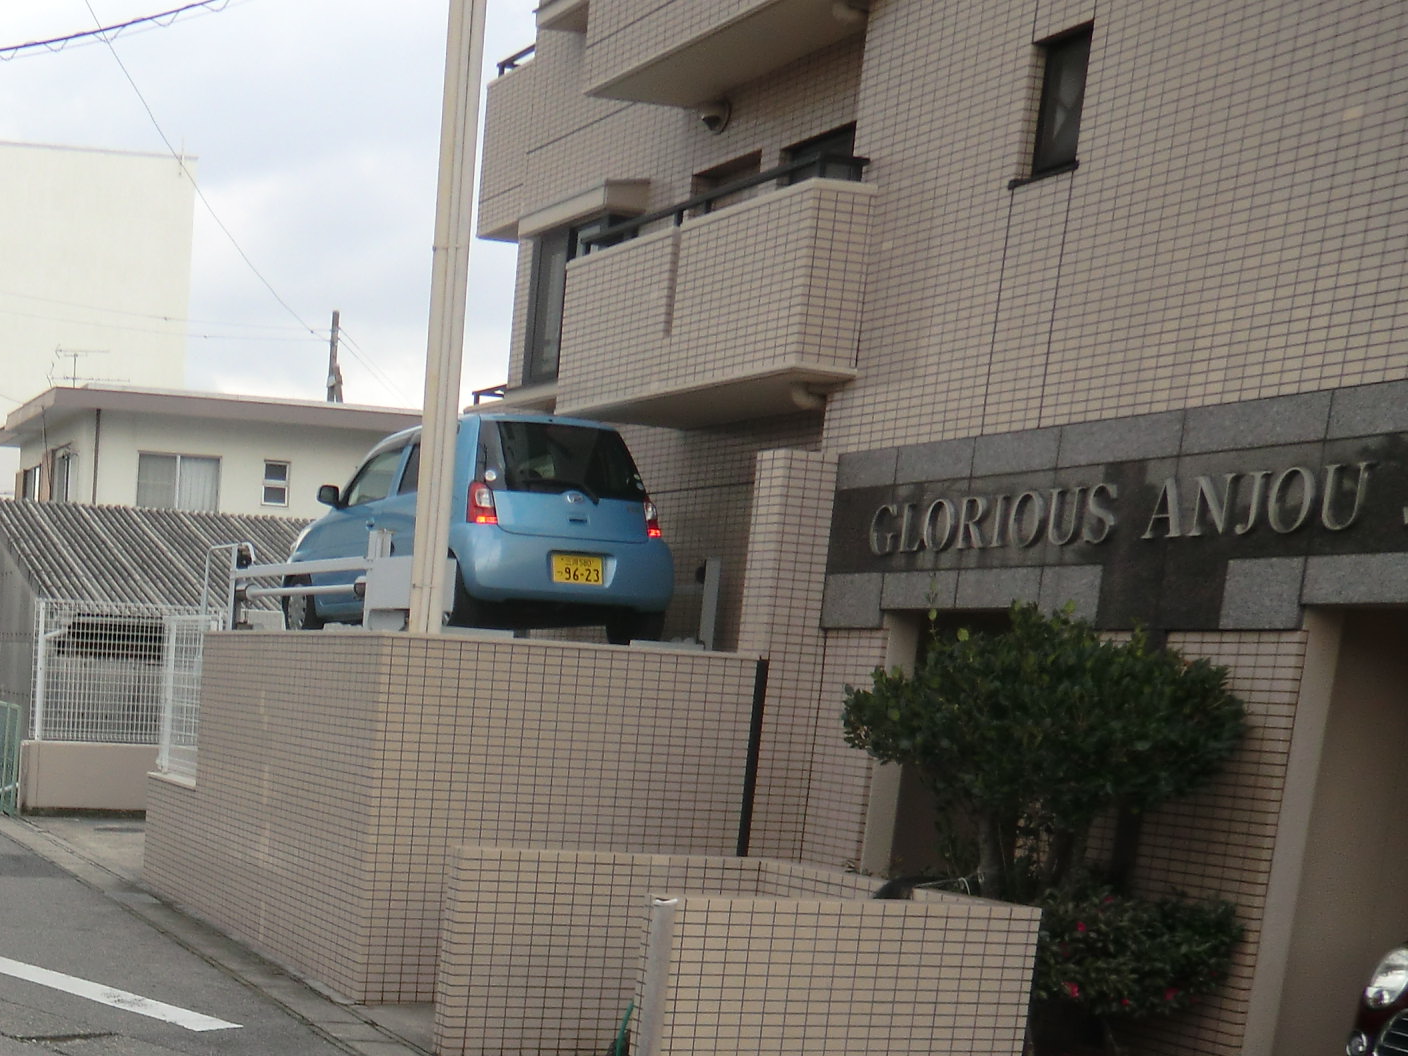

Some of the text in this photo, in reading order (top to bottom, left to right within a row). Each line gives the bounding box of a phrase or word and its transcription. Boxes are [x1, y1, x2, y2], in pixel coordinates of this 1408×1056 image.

[869, 461, 1377, 556] GLORIOUS ANJOU
[564, 566, 600, 583] 96-23
